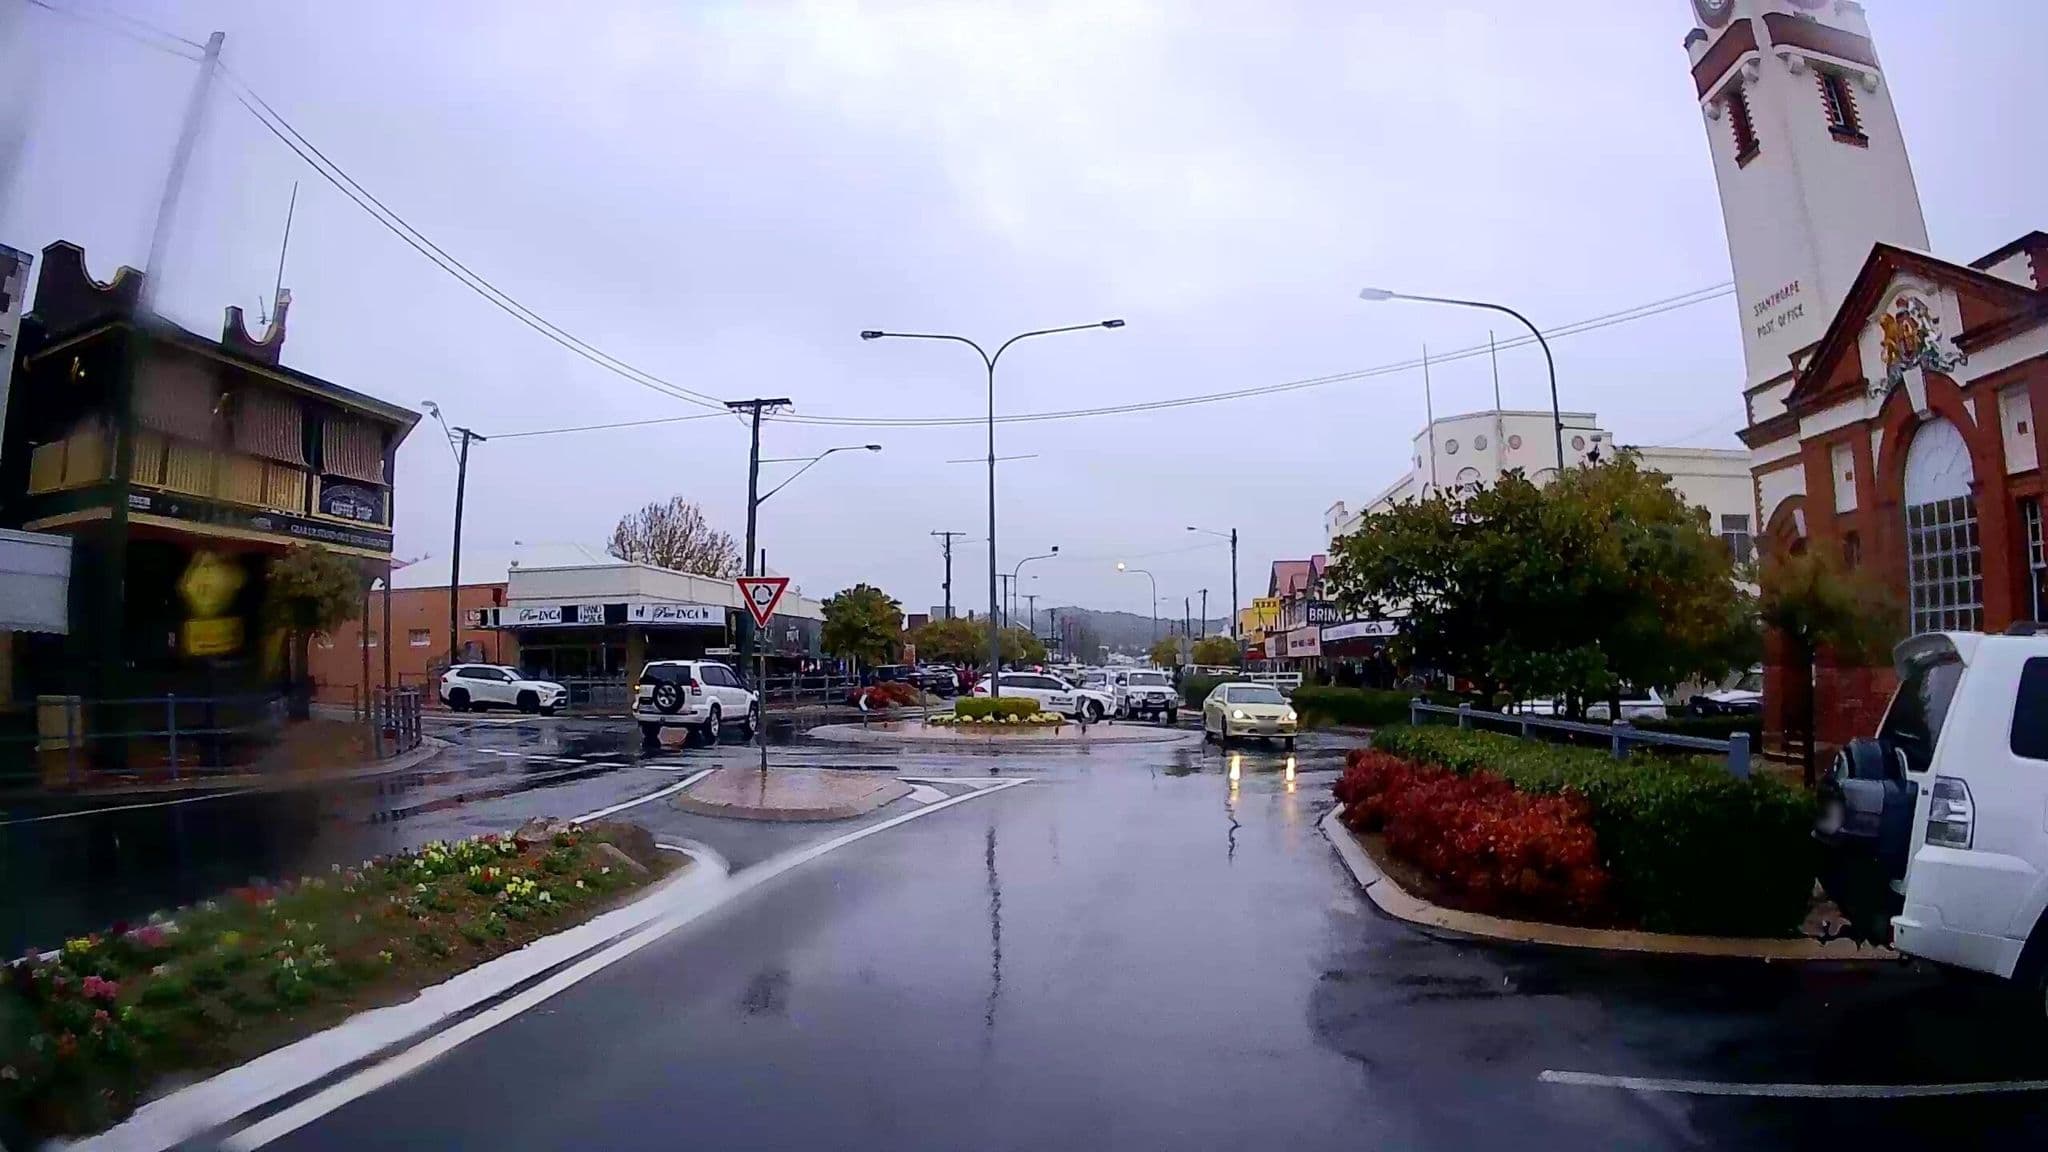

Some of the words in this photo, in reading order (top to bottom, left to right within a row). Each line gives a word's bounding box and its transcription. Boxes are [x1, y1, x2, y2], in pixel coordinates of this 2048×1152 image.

[1753, 280, 1800, 317] STANTHORPE
[1757, 318, 1774, 338] POST
[1778, 303, 1804, 327] OFFICE
[1309, 607, 1344, 622] BRINX
